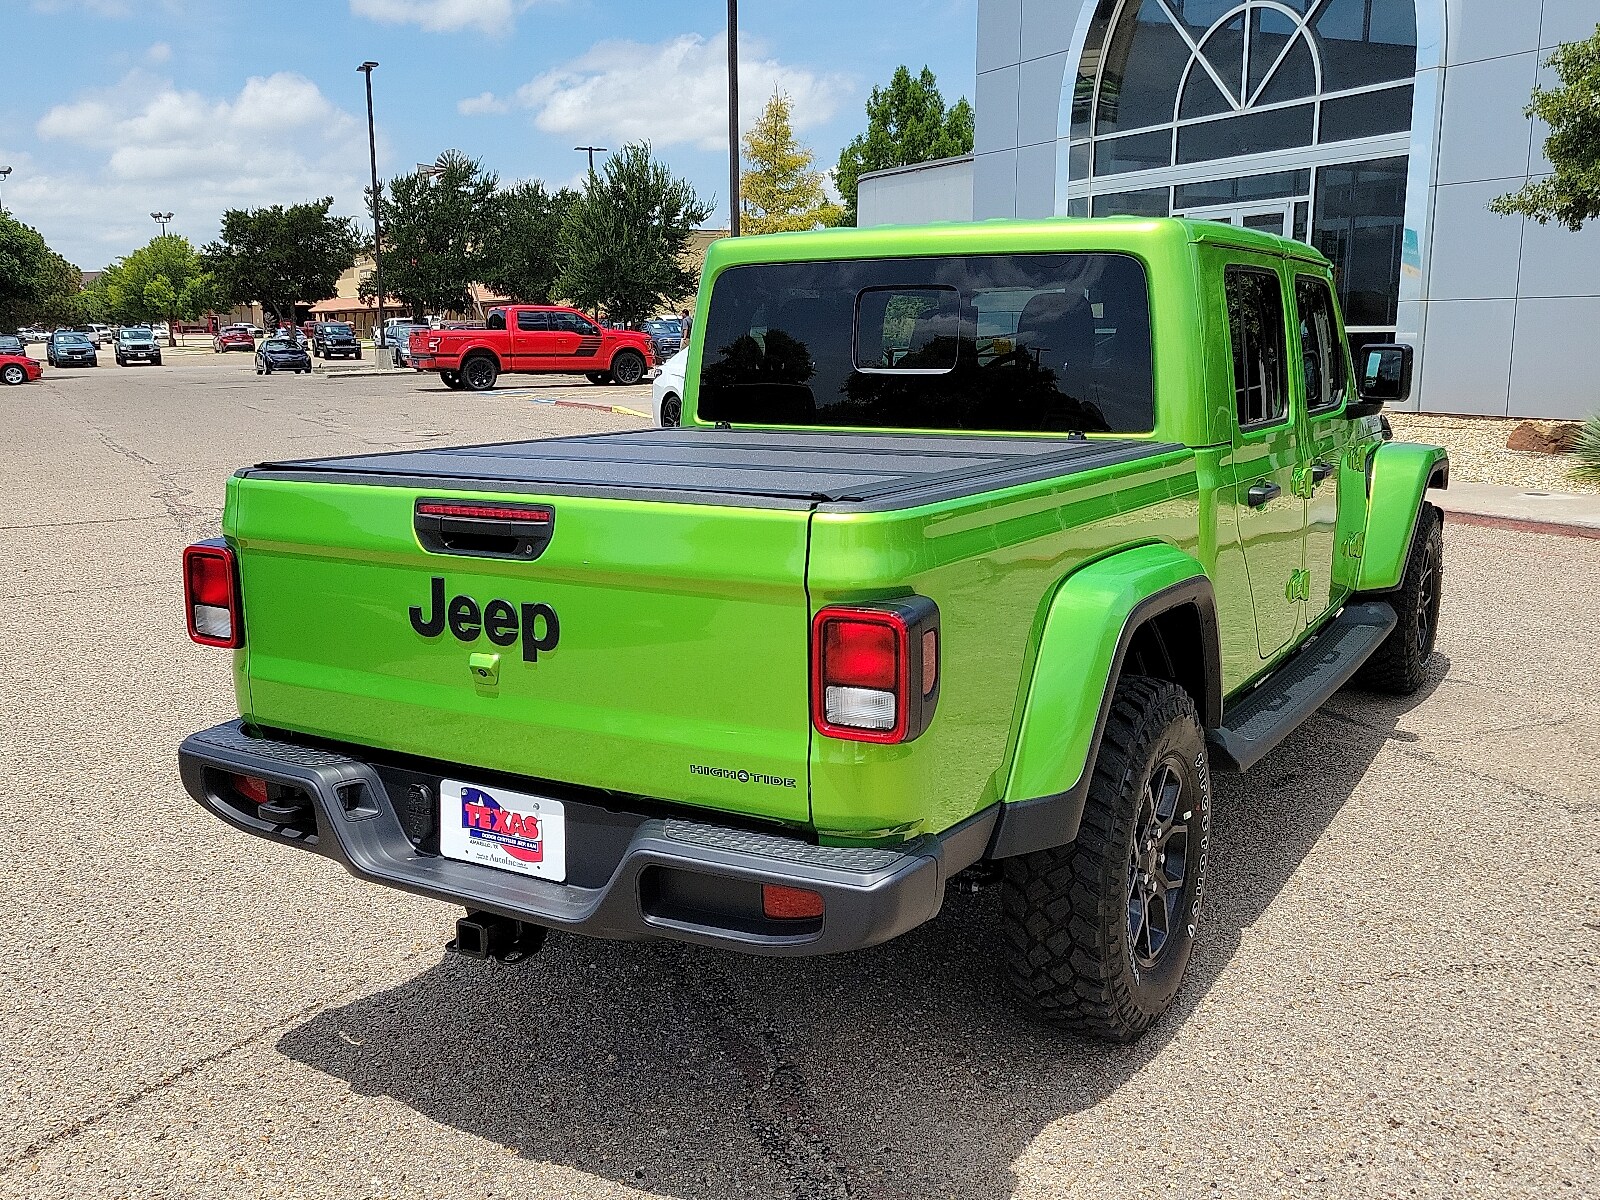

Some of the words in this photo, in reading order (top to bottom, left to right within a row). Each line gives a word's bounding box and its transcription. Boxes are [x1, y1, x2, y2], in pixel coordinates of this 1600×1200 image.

[408, 575, 560, 662] Jeep
[690, 764, 737, 780] HIGH
[750, 772, 797, 789] TIDE
[465, 803, 539, 840] TEXAS
